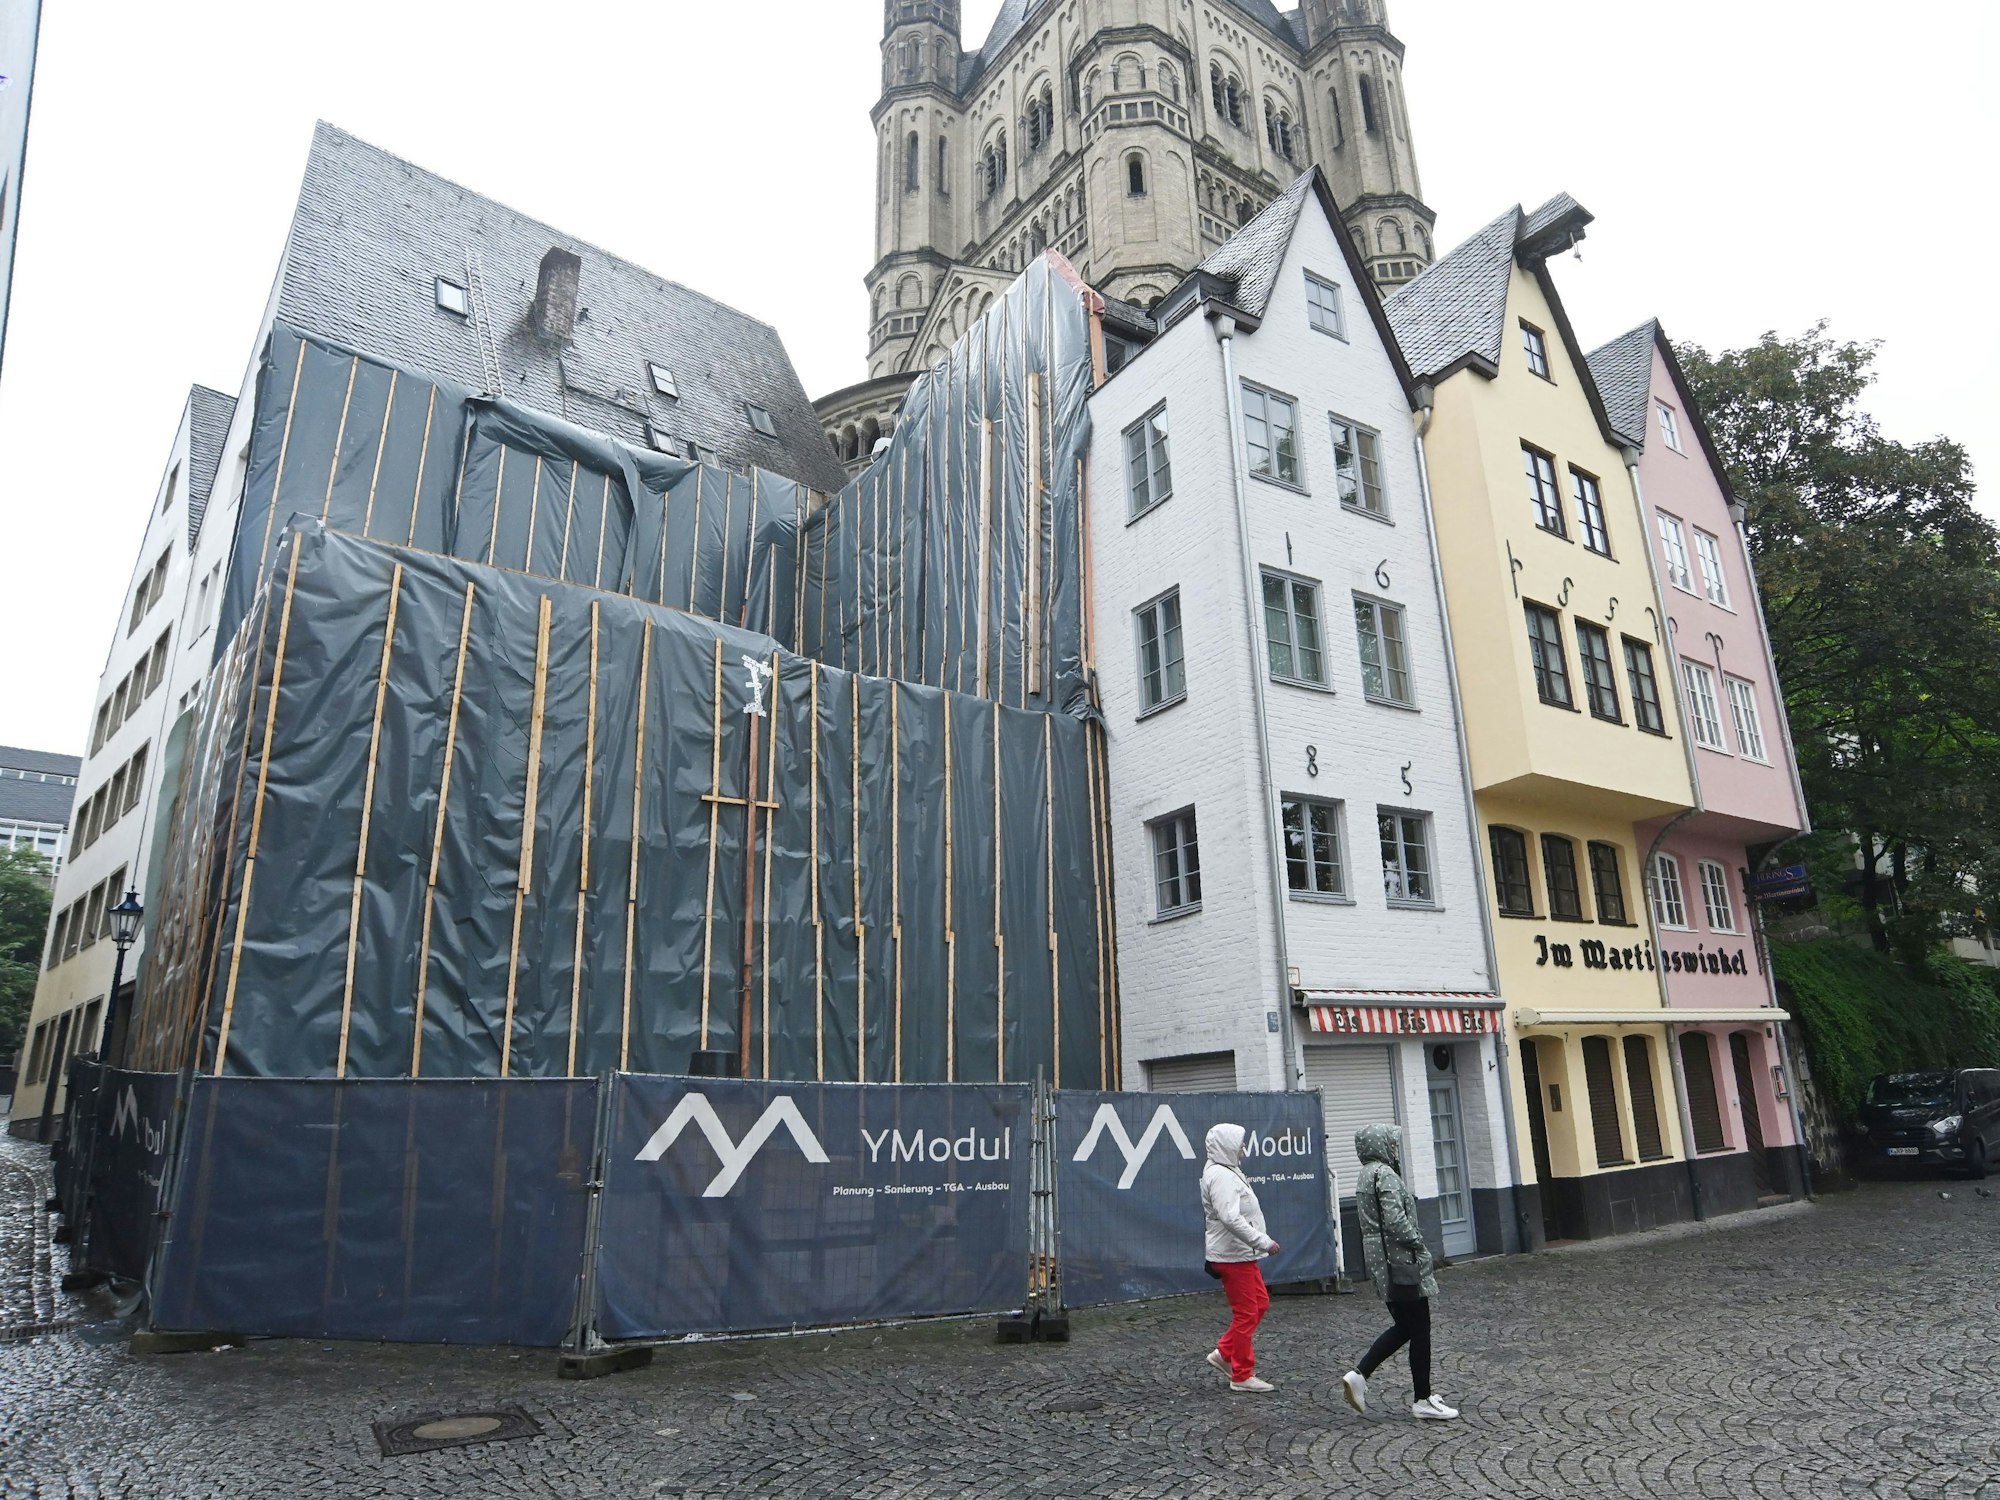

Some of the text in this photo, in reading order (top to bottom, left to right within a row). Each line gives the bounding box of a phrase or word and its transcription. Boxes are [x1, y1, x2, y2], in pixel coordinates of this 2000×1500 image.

[1534, 935, 1573, 968] Im
[1333, 1010, 1361, 1030] Eis
[1398, 1012, 1427, 1030] Eis
[1462, 1013, 1486, 1030] Eis
[860, 1127, 1010, 1162] YModul
[1243, 1127, 1312, 1157] Modul
[833, 1185, 874, 1197] Planung
[884, 1184, 934, 1195] Sanierung
[943, 1183, 965, 1192] TGA
[975, 1182, 1009, 1191] Ausbau
